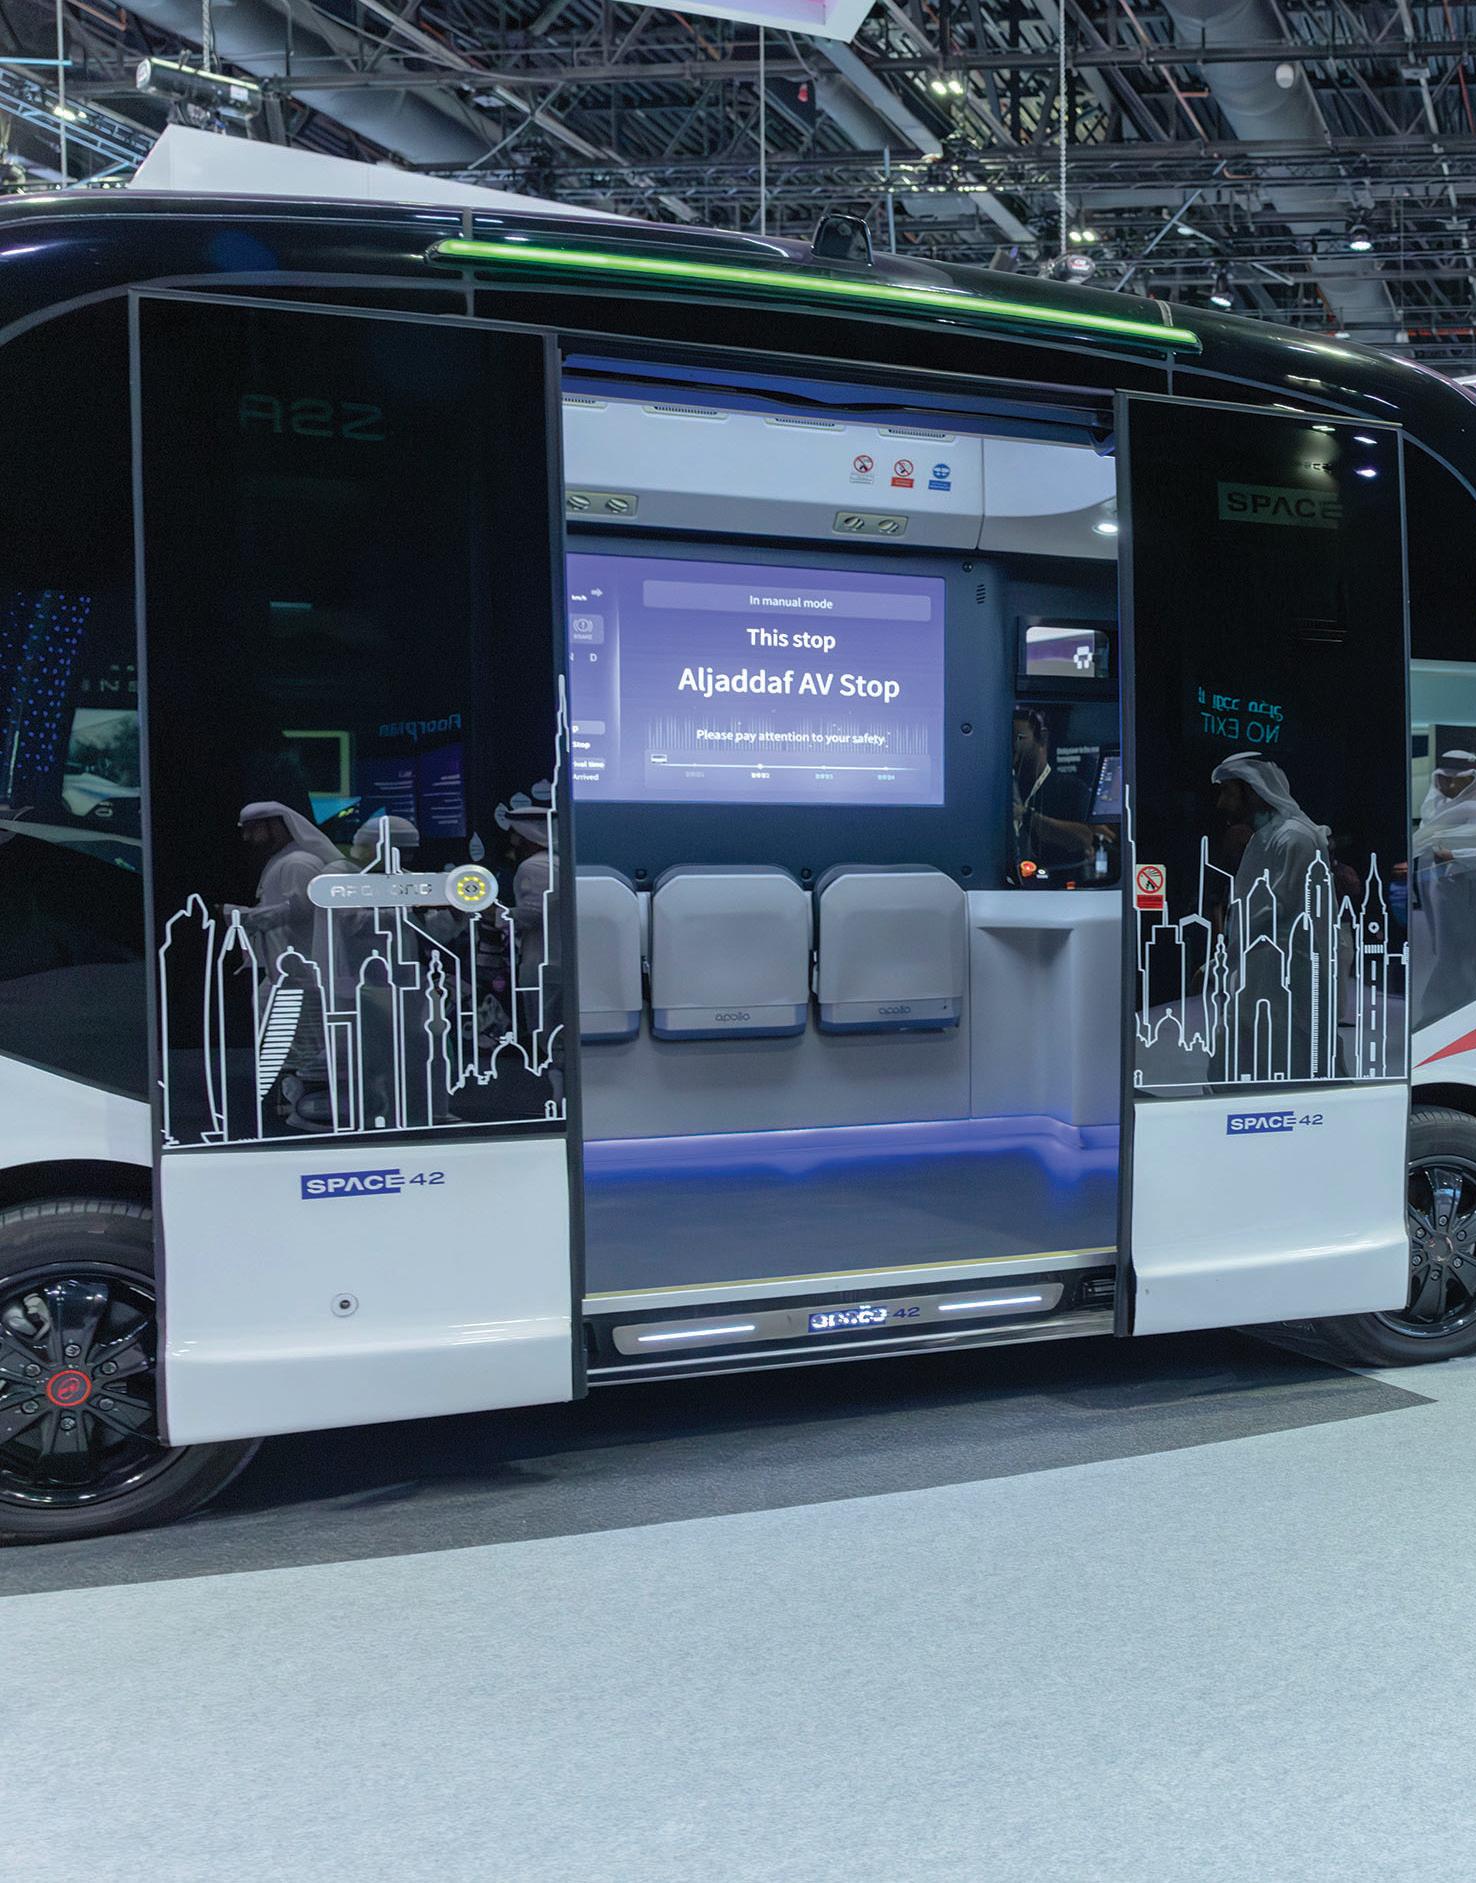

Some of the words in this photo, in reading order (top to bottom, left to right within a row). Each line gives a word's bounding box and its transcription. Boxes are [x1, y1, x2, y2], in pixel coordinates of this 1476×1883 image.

[1227, 491, 1343, 520] SPACE
[750, 595, 760, 605] In
[762, 596, 801, 607] manual
[803, 598, 833, 609] mode
[746, 628, 789, 648] This
[792, 631, 836, 653] stop
[678, 667, 794, 698] Aljaddaf
[798, 672, 834, 695] AV
[839, 673, 900, 703] Stop
[696, 729, 733, 741] Please
[735, 732, 757, 743] pay
[759, 731, 809, 742] attention
[812, 732, 823, 742] to
[825, 734, 850, 745] your
[1230, 1115, 1297, 1131] SPACE
[1298, 1113, 1324, 1126] 42
[306, 1173, 405, 1195] SPACE
[409, 1171, 446, 1186] 42
[893, 1306, 921, 1318] 42
